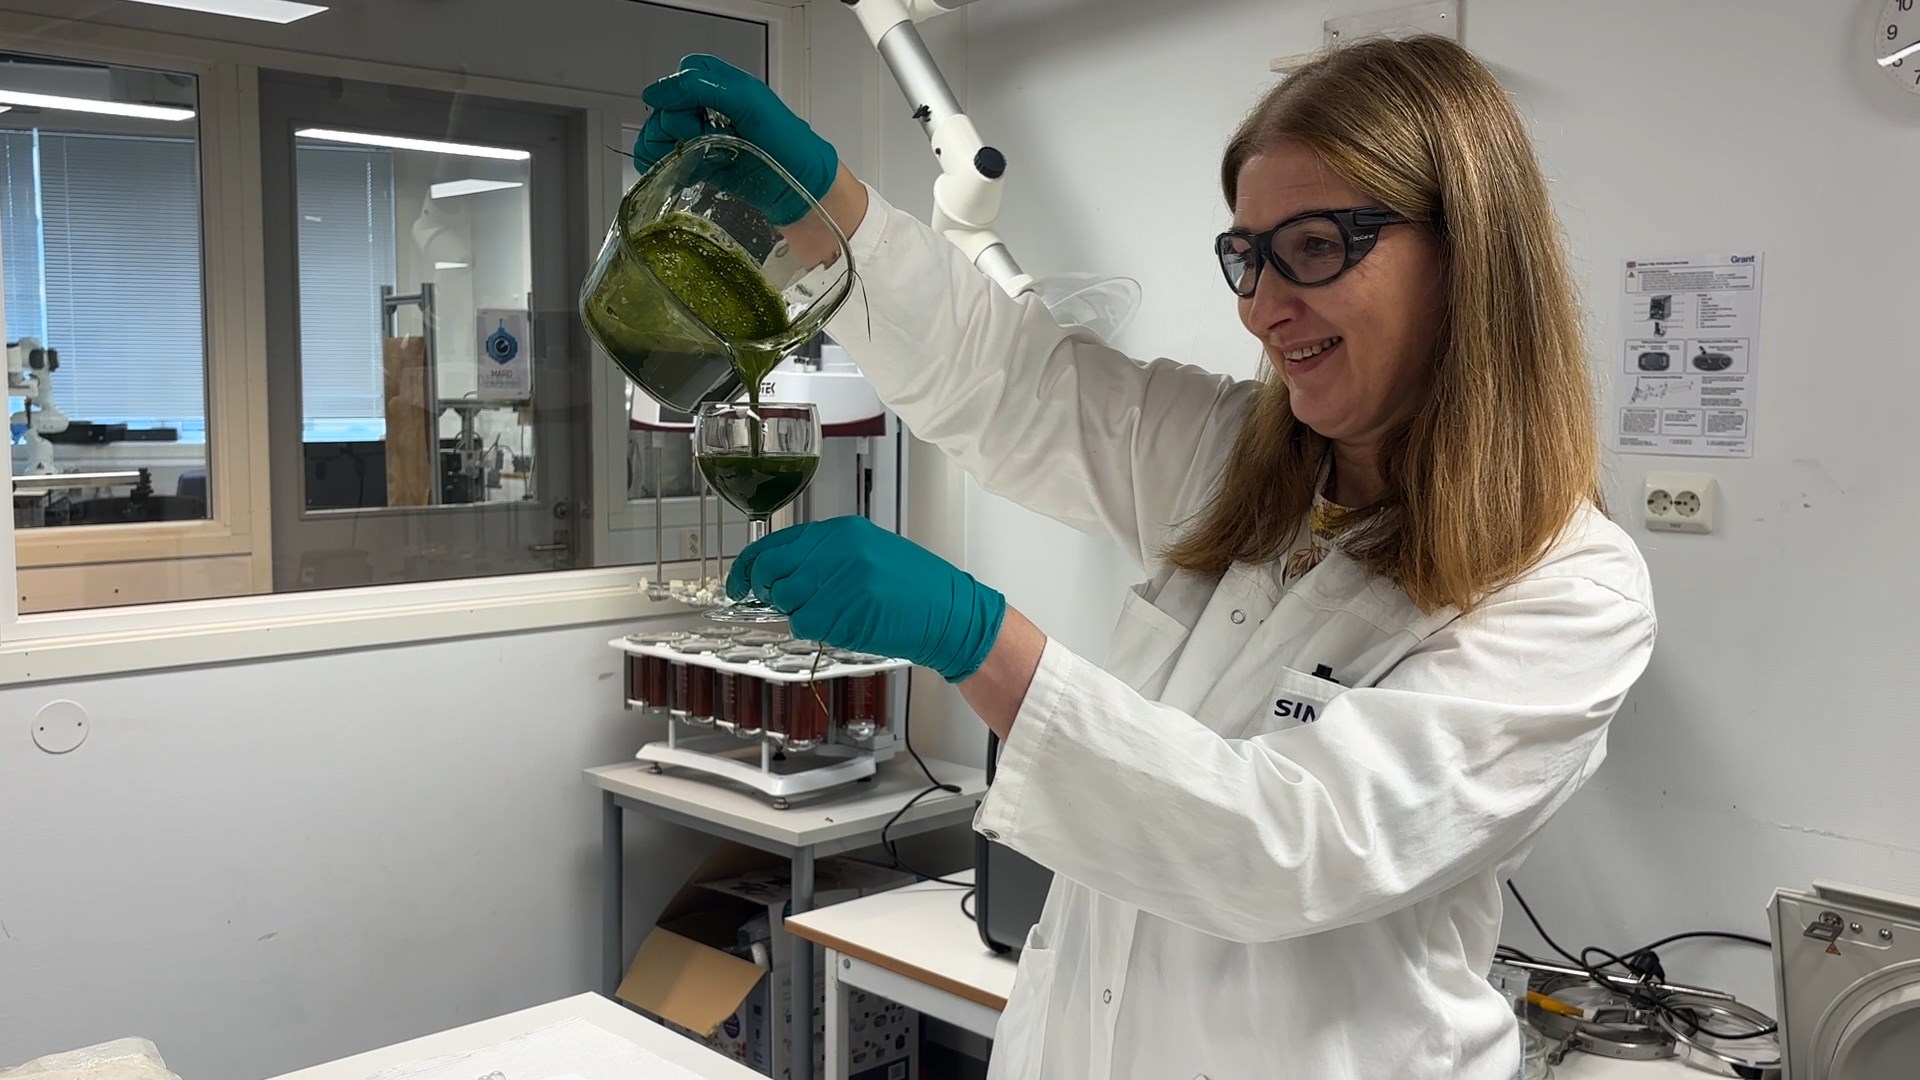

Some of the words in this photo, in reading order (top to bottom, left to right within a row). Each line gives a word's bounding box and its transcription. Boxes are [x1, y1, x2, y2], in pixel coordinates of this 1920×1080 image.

[1887, 24, 1898, 41] 9
[1730, 255, 1755, 264] Grant
[758, 382, 775, 394] TEK
